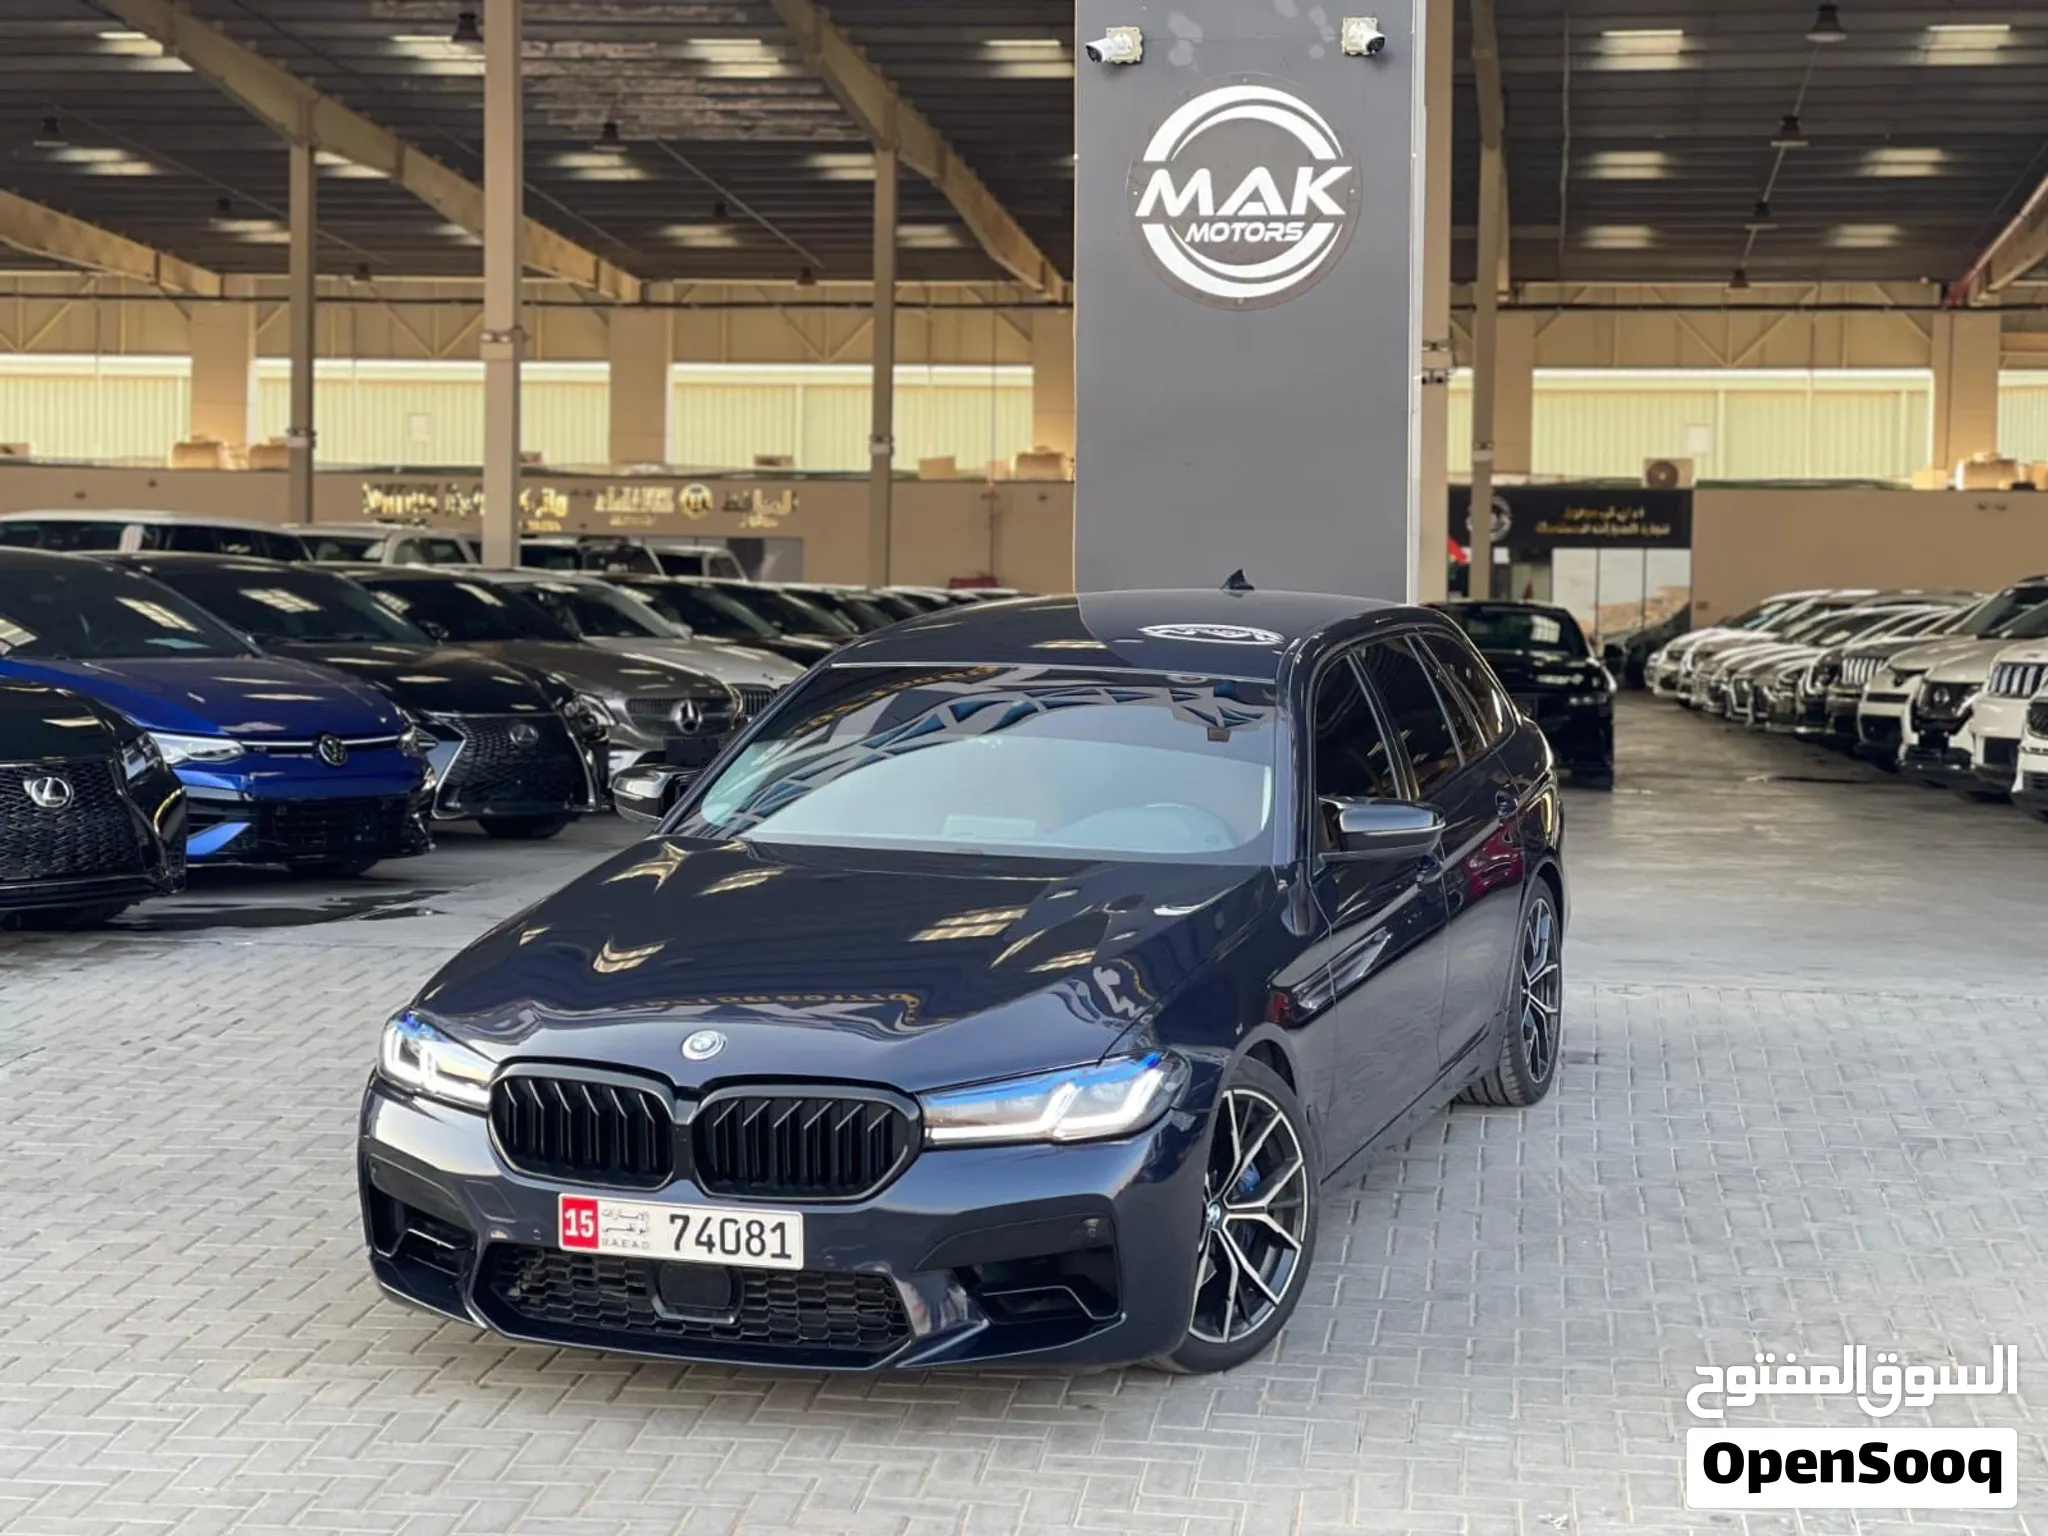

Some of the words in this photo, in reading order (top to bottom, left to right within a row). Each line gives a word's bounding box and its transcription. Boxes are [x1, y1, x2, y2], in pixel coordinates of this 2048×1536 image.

[1135, 166, 1352, 217] MAK
[1184, 221, 1305, 243] MOTORS
[564, 1208, 595, 1238] 15
[669, 1213, 792, 1260] 74081
